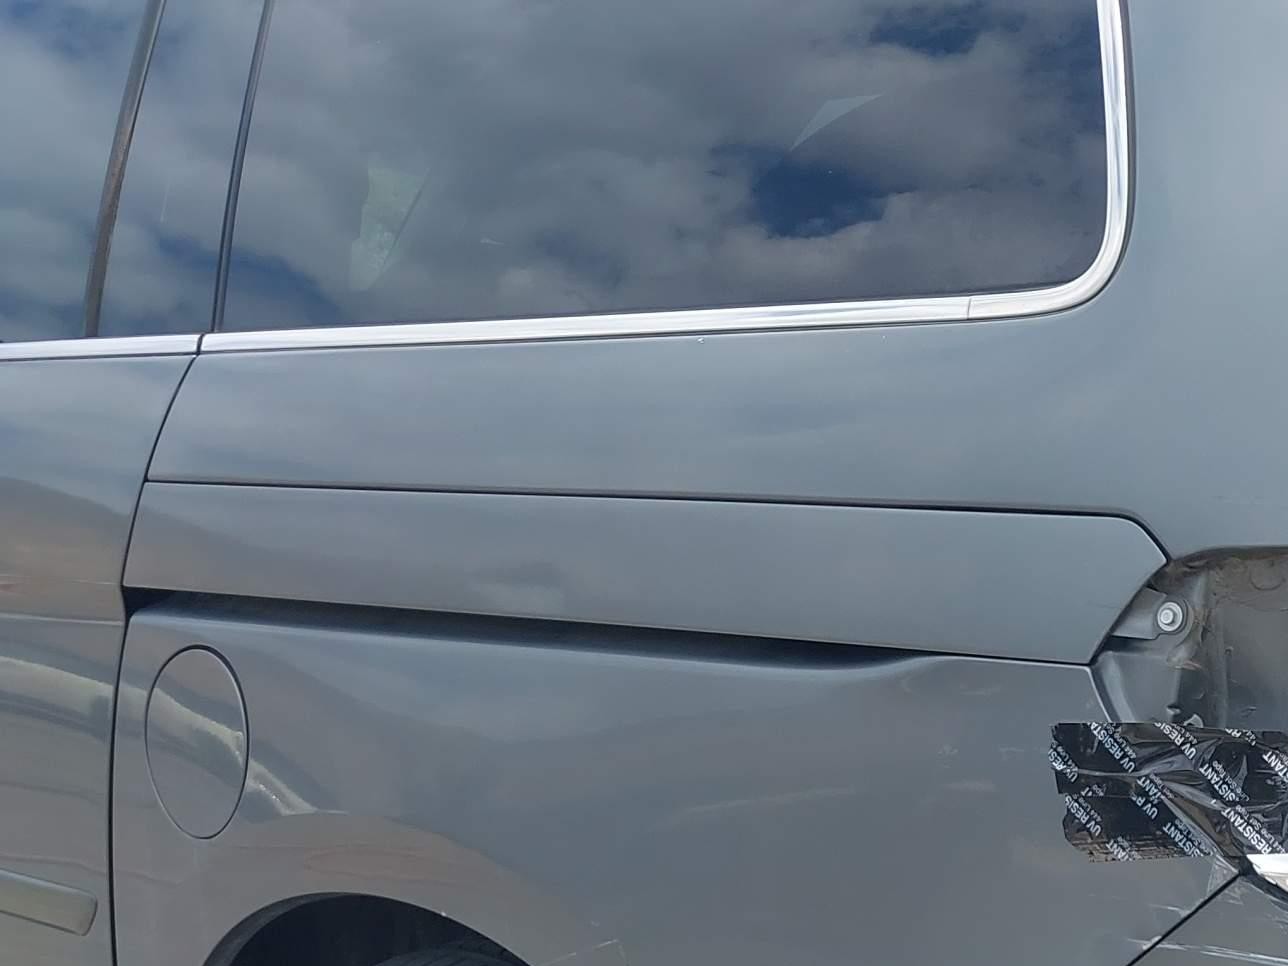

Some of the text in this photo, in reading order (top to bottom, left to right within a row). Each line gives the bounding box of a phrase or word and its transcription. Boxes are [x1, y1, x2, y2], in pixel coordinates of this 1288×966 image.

[1181, 742, 1197, 760] UV
[1120, 759, 1137, 773] UV
[1199, 763, 1239, 802] SISTANT
[1143, 804, 1159, 820] UV
[1087, 822, 1102, 836] UV
[1220, 807, 1273, 855] RESISTANT
[1162, 822, 1203, 857] SISTANT
